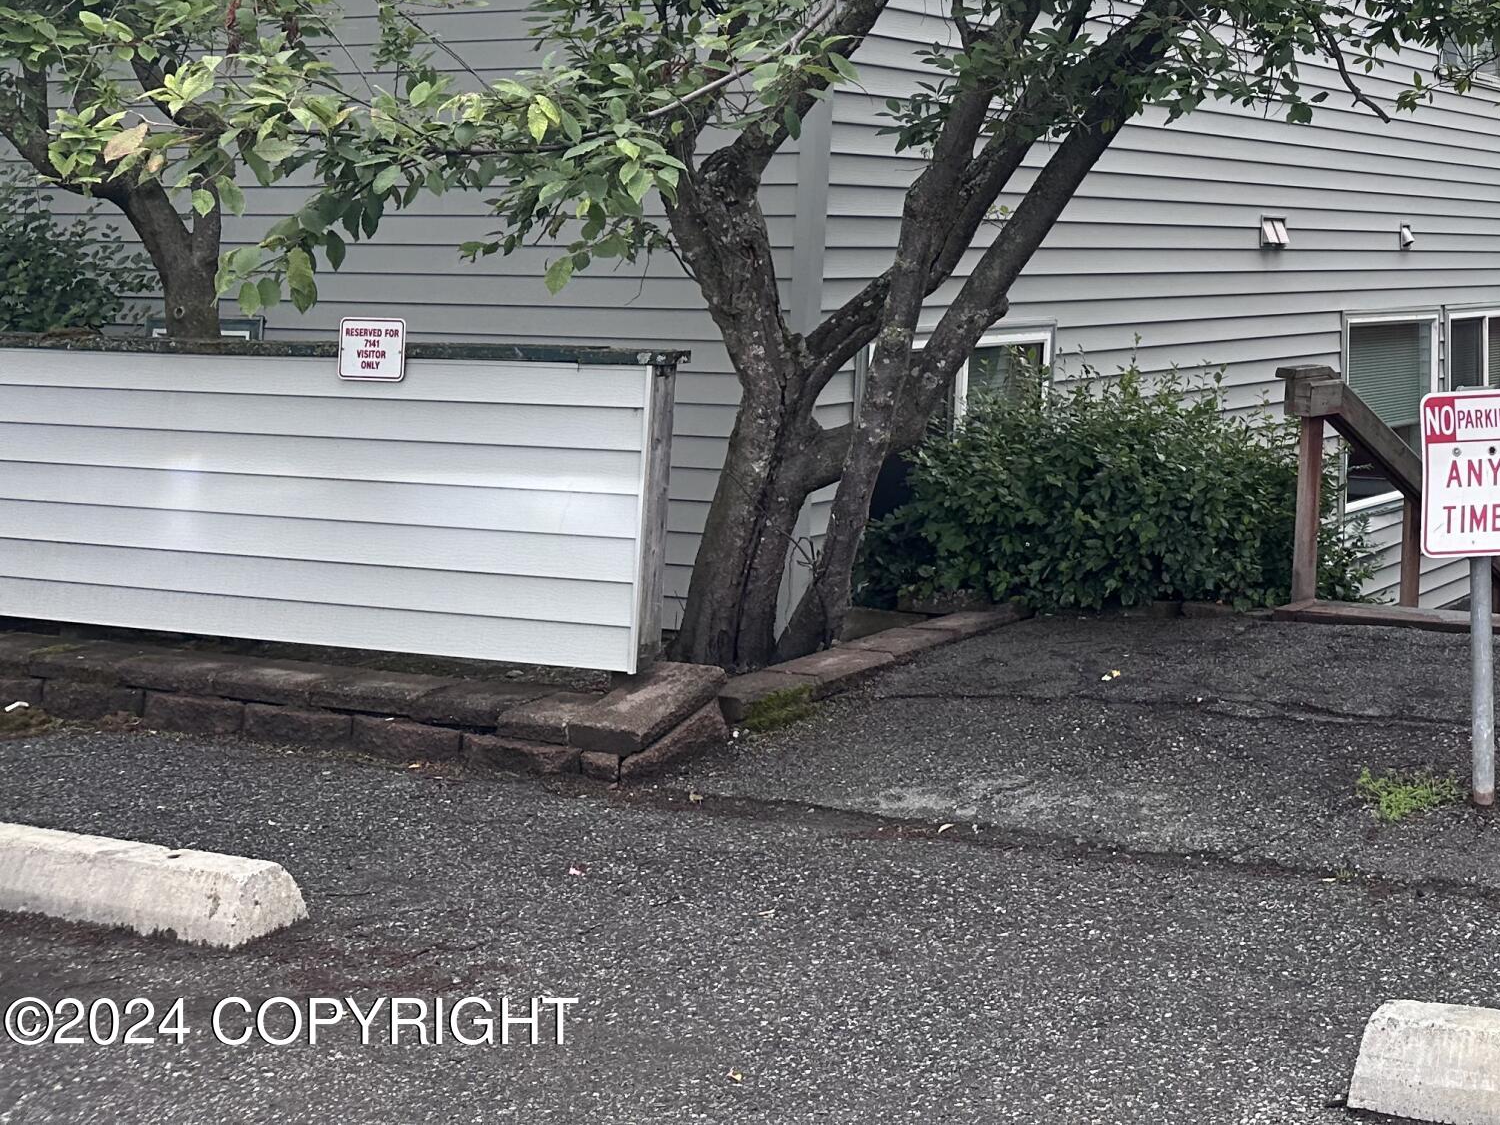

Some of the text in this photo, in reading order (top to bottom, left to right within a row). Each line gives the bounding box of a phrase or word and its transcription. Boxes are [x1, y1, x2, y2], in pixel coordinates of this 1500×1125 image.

[345, 327, 400, 338] RESERVED FOR
[364, 339, 380, 348] 7141
[356, 349, 386, 359] VISITOR
[360, 360, 380, 370] ONLY
[1425, 405, 1455, 436] NO
